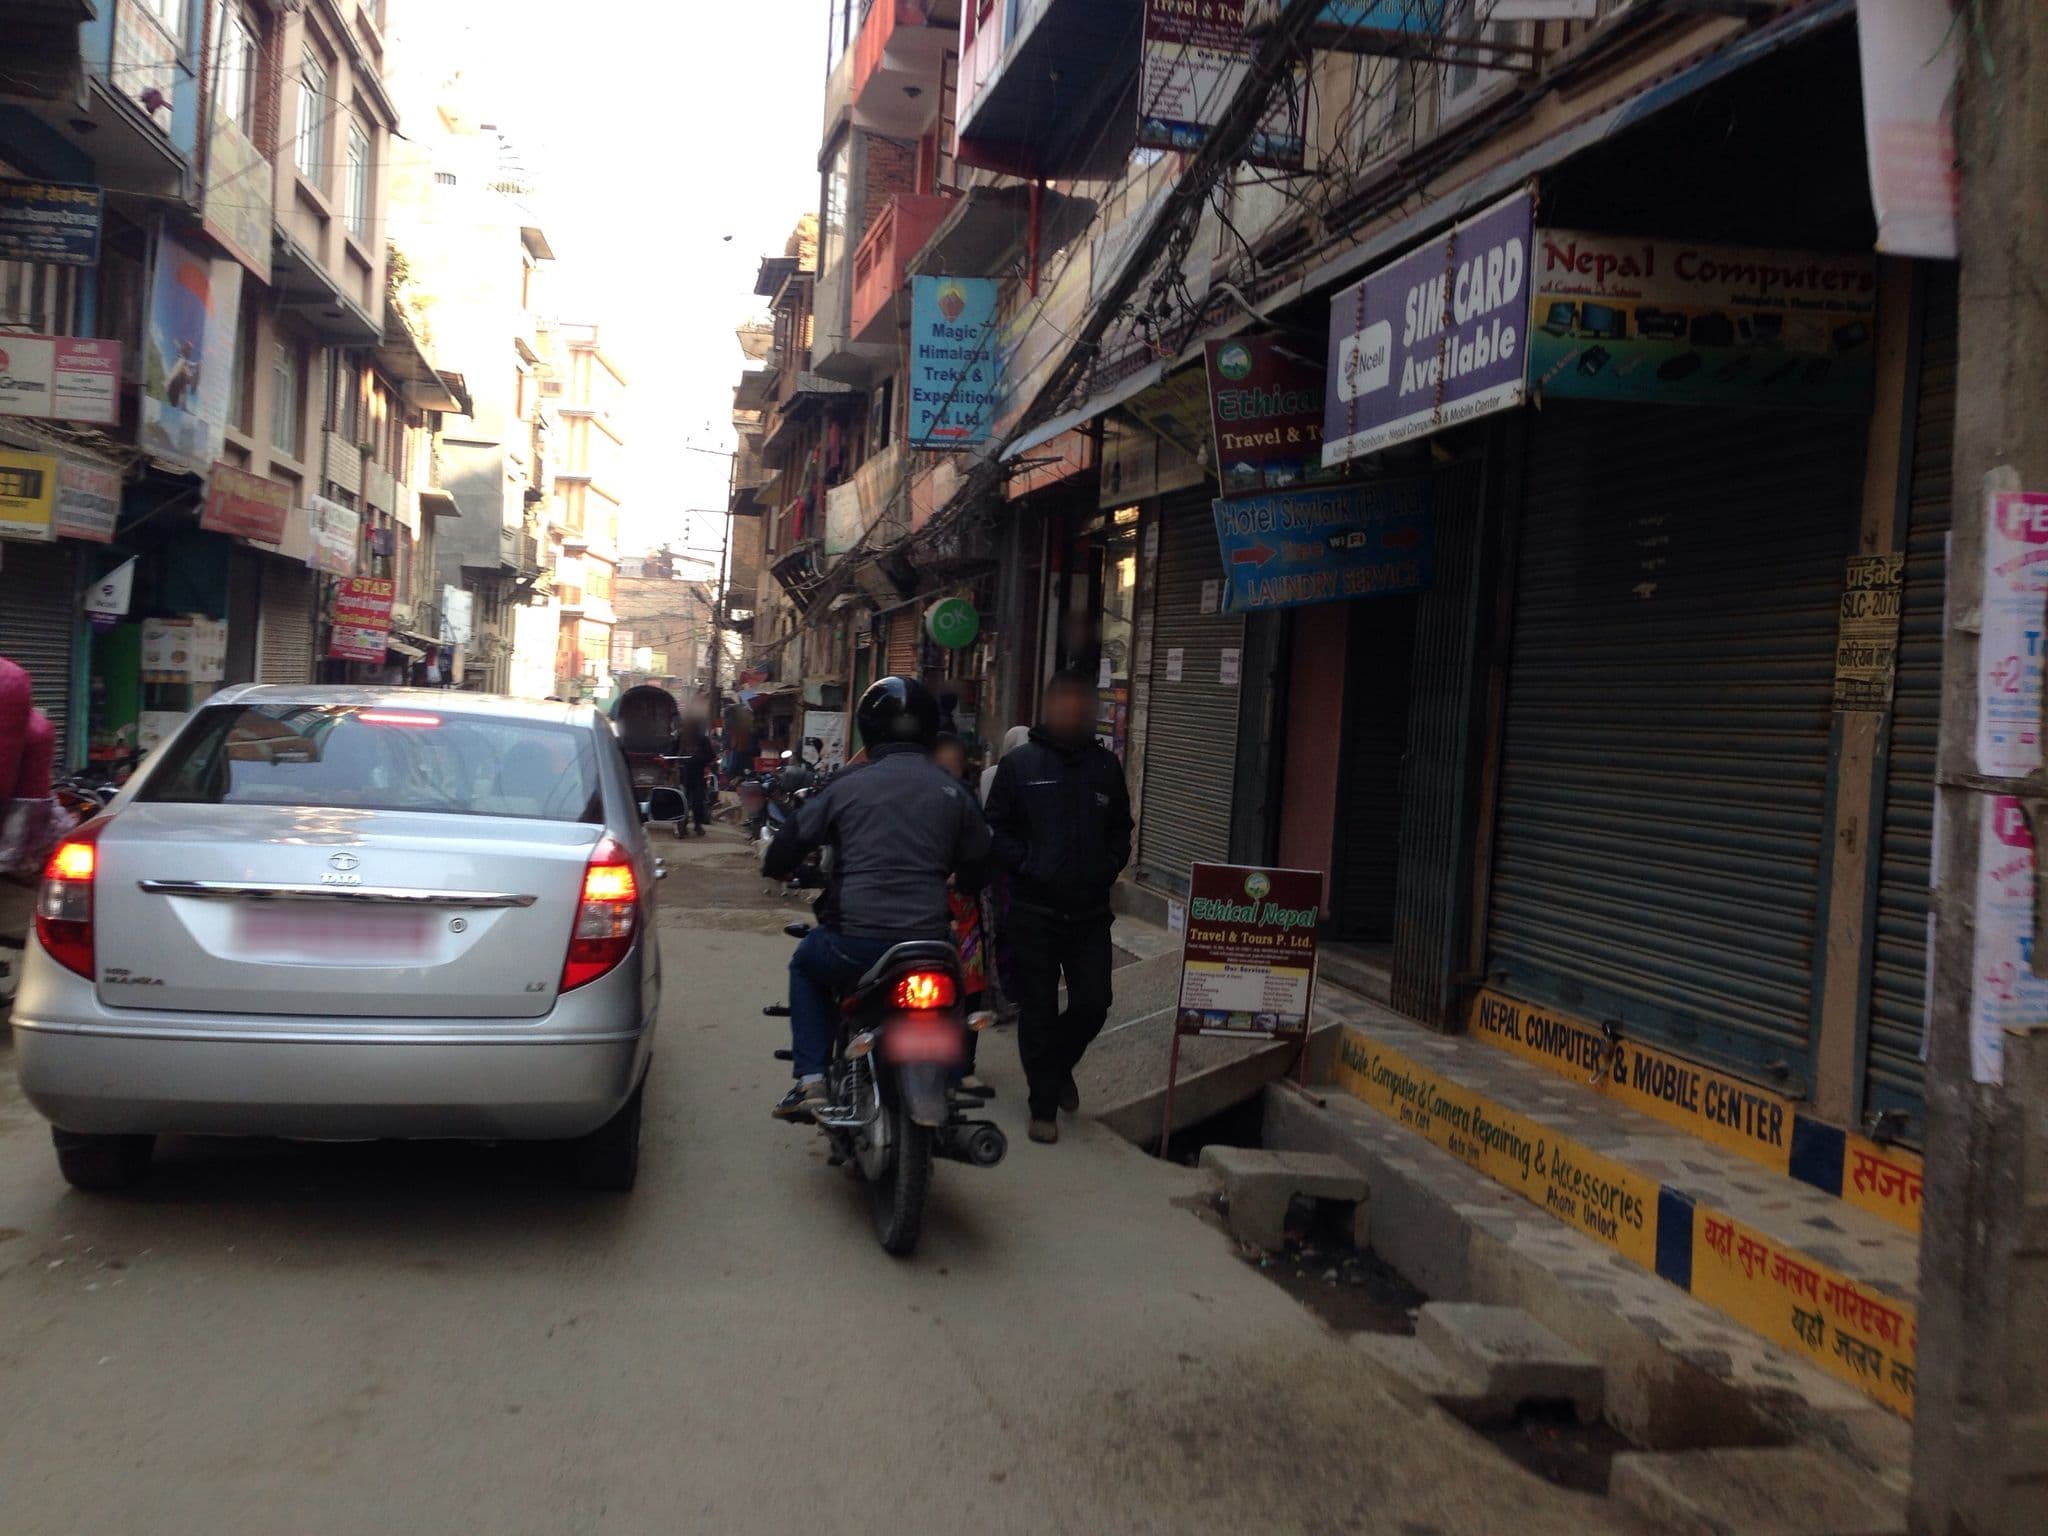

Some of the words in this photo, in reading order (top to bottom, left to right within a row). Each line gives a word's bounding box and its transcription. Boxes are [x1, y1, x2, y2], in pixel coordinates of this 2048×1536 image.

[1218, 3, 1244, 22] Tou
[1543, 240, 1654, 283] Nepal
[1674, 250, 1875, 293] Computers
[1403, 273, 1447, 348] SIM
[1453, 237, 1524, 326] CARD
[932, 323, 978, 341] Magic
[919, 345, 989, 362] Himalaya
[1359, 345, 1385, 373] Ncell
[1399, 318, 1516, 397] Available
[924, 367, 967, 381] Treks
[972, 368, 983, 382] &
[913, 388, 994, 405] Expedition
[1450, 405, 1474, 422] Mobile
[1475, 396, 1500, 413] Center
[1222, 427, 1280, 450] Travel
[1287, 426, 1301, 442] &
[1223, 499, 1275, 536] Hotel
[351, 578, 393, 597] STAR
[1248, 570, 1339, 606] LAUNDRY
[1343, 560, 1420, 594] SERVICE
[939, 608, 969, 630] OK
[1990, 655, 2021, 693] +2
[320, 872, 363, 884] TATA
[1191, 896, 1258, 924] Ethical
[1258, 902, 1318, 932] Nepal
[1190, 928, 1225, 943] Travel
[1228, 930, 1238, 943] &
[1241, 932, 1273, 945] Tours
[1277, 933, 1287, 946] P.
[1291, 935, 1312, 948] Ltd.
[1224, 964, 1237, 973] Our
[1479, 997, 1522, 1041] NEPAL
[1613, 1046, 1628, 1084] &
[1632, 1053, 1699, 1114] MOBILE
[1704, 1079, 1784, 1146] CENTER
[1371, 1054, 1418, 1106] Computer
[1418, 1080, 1426, 1109] &
[1427, 1083, 1471, 1132] Camera
[1472, 1105, 1531, 1182] Repairing
[1534, 1138, 1546, 1179] &
[1551, 1144, 1644, 1230] Accessories
[1583, 1201, 1618, 1243] Unlock
